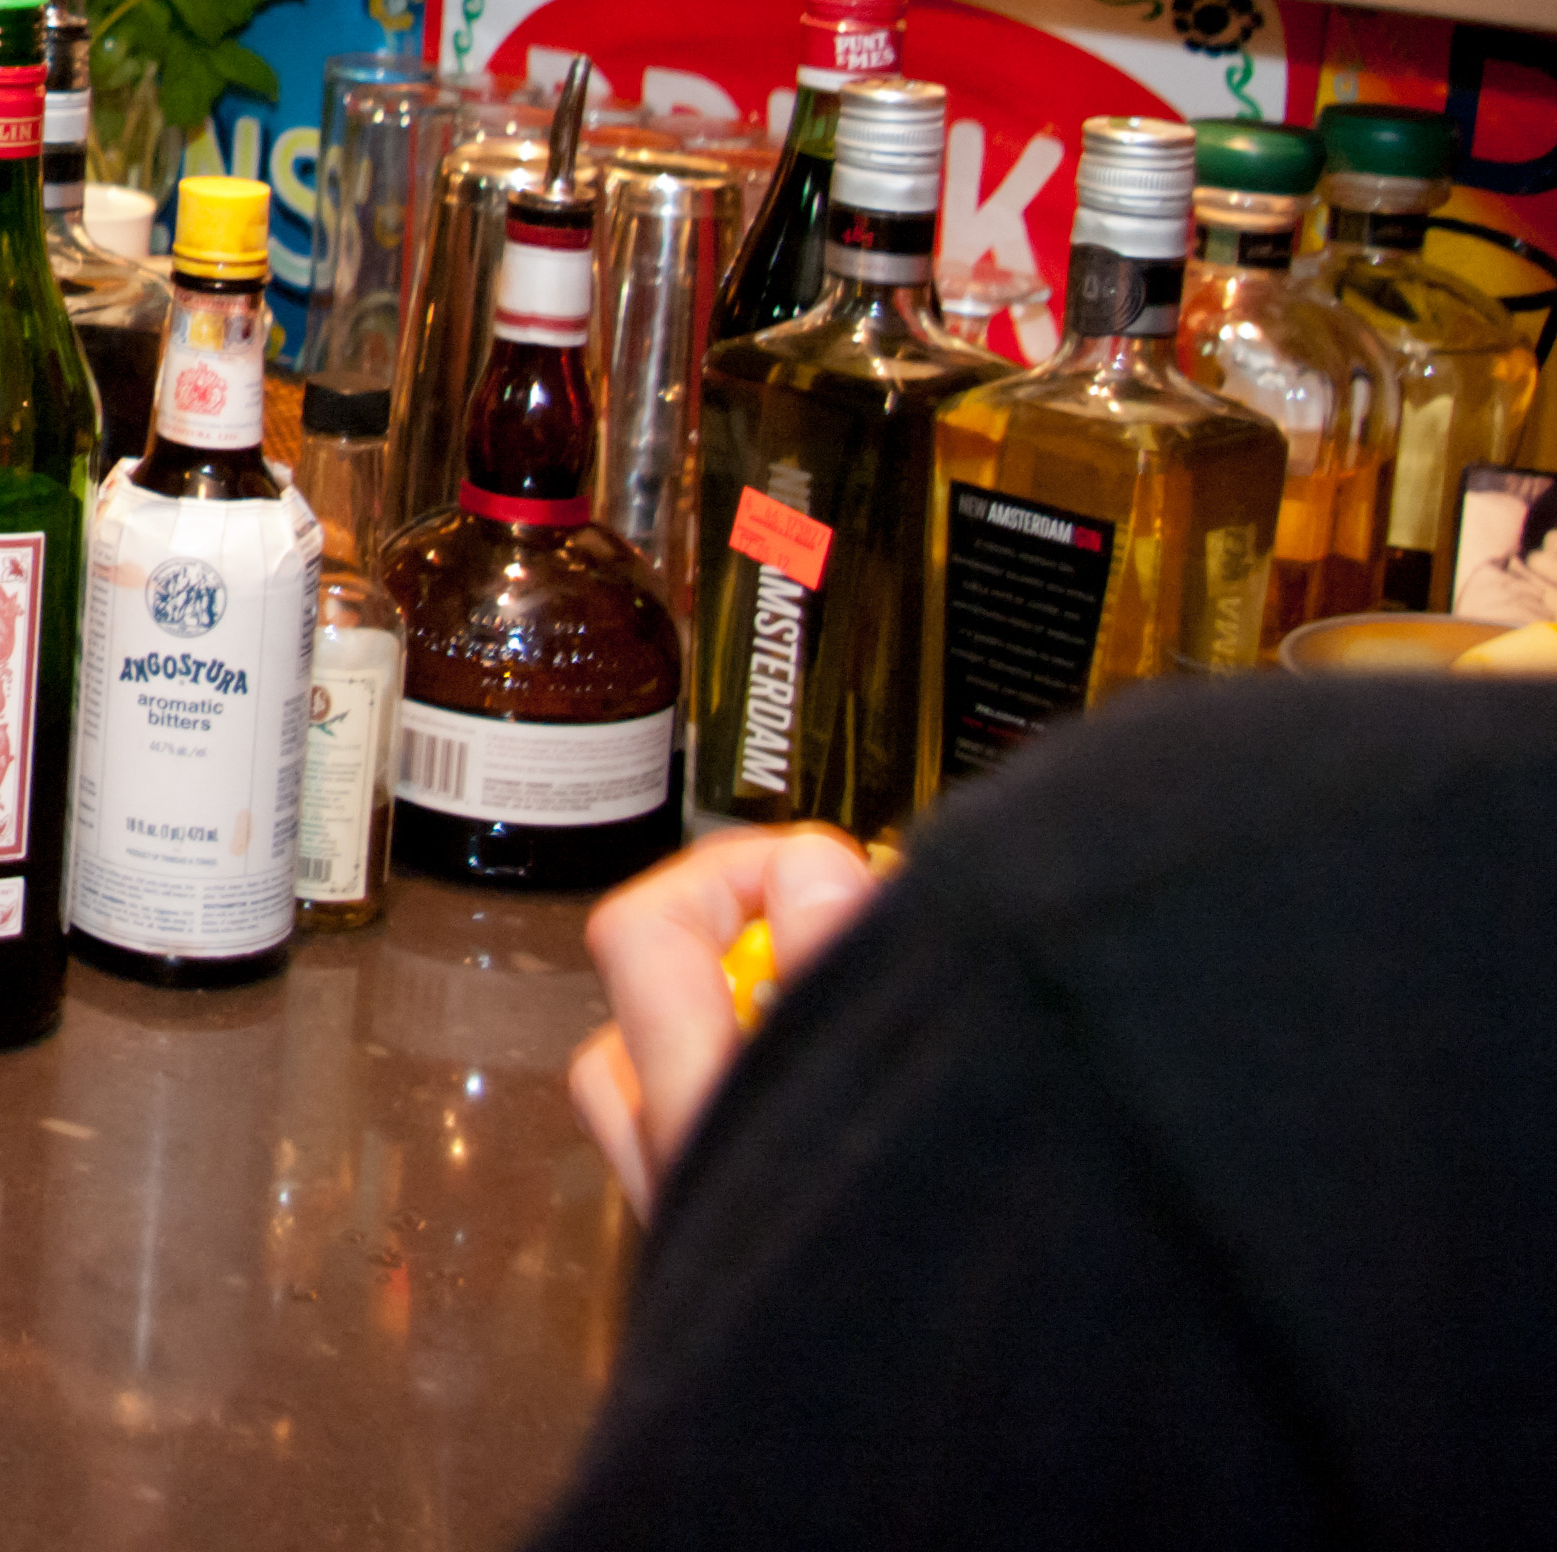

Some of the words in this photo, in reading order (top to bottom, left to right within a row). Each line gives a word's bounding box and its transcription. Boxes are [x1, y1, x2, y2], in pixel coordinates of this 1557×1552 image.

[835, 29, 889, 54] PUNT
[986, 500, 1075, 545] AMSTERDAM
[119, 651, 249, 695] ANGOSTURA
[742, 564, 804, 792] MSTERDAM
[137, 693, 224, 715] aromatic
[147, 708, 212, 732] bitters
